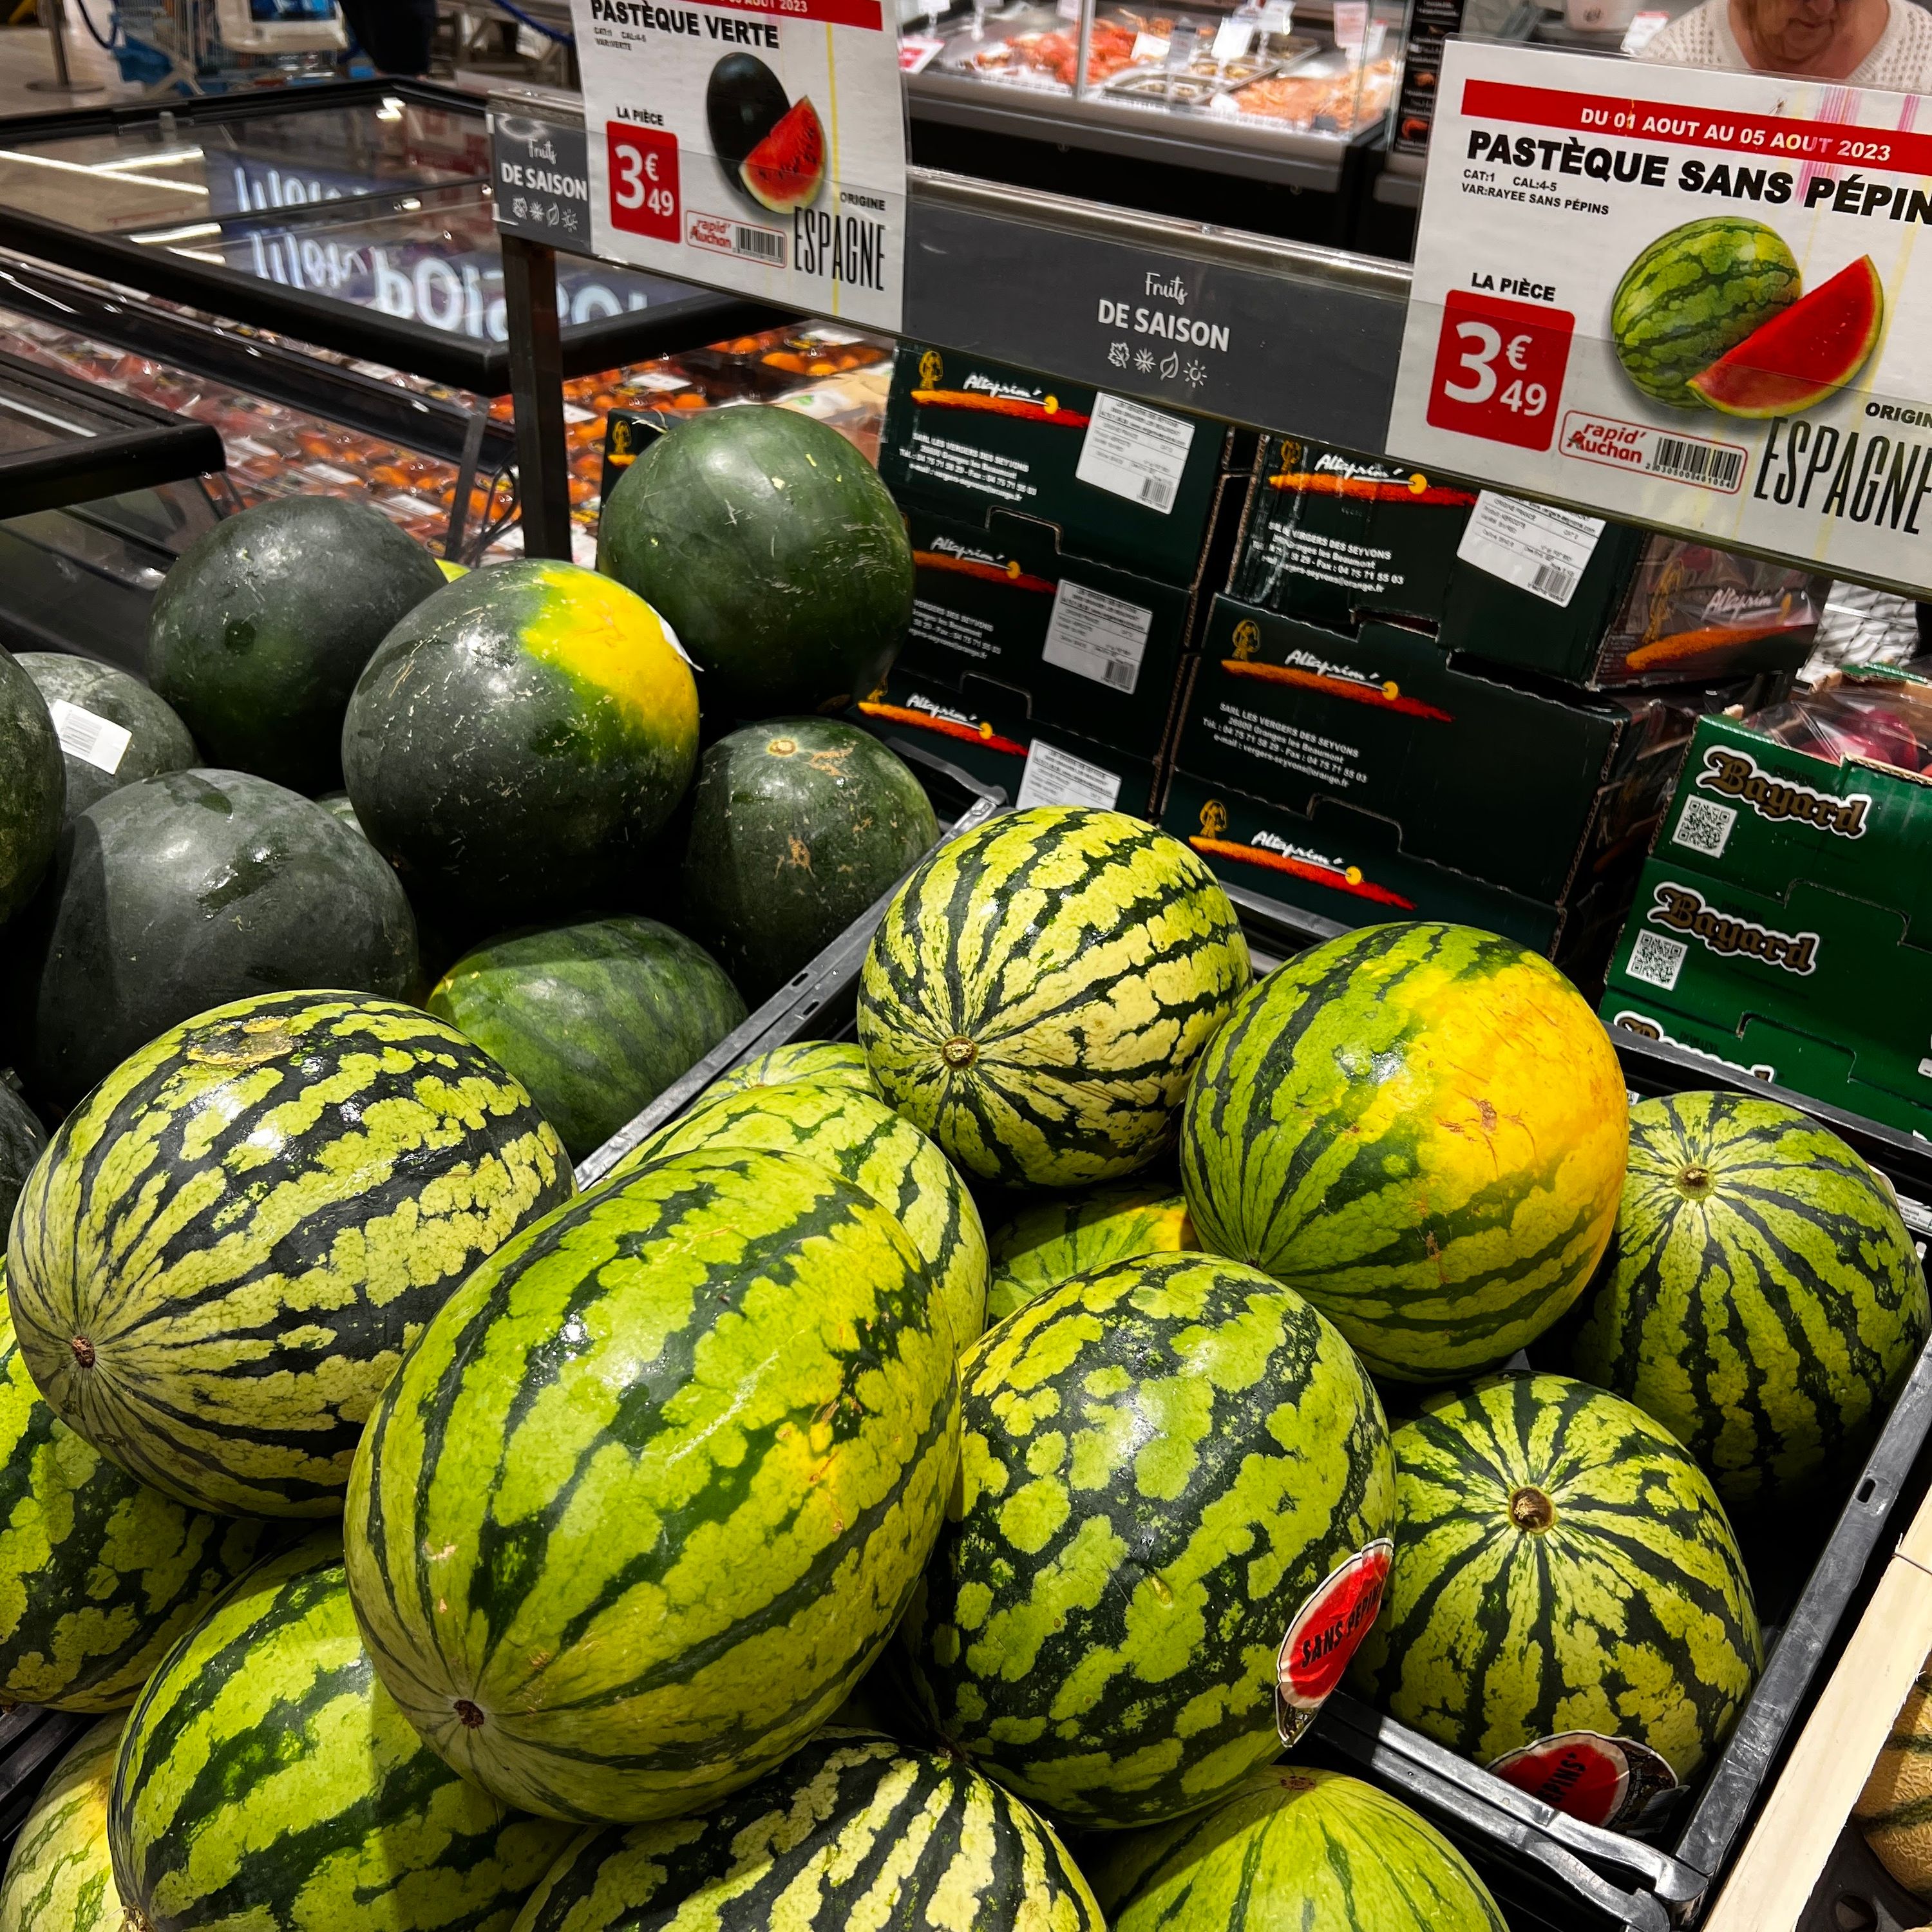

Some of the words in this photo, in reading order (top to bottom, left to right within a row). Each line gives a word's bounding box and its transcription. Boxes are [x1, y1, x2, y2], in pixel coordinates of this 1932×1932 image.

[591, 0, 700, 35] PASTÈQUE
[705, 14, 780, 48] VERTE
[780, 0, 808, 12] 2023
[617, 106, 631, 120] LA
[634, 109, 664, 126] PIÈCE
[1581, 108, 1609, 126] DU
[1613, 112, 1636, 129] 01
[1642, 116, 1700, 137] AOUT
[1704, 124, 1734, 142] AU
[1739, 128, 1765, 146] 05
[1770, 132, 1833, 153] AOUT
[1837, 139, 1891, 162] 2023
[501, 162, 523, 186] DE
[526, 168, 588, 201] SAISON
[615, 144, 645, 209] 3
[647, 189, 674, 216] 49
[1464, 169, 1495, 182] CAT:1
[1513, 176, 1558, 192] CAL:4-5
[1467, 129, 1669, 187] PASTÈQUE
[1678, 159, 1794, 204] SANS
[840, 192, 886, 211] ORIGINE
[1461, 183, 1526, 201] VAR:RAYEE
[1529, 194, 1561, 207] SANS
[1564, 199, 1609, 215] PÉPINS
[690, 225, 732, 249] Auchan
[794, 205, 886, 291] ESPAGNE
[1145, 272, 1188, 305] Fruits
[1472, 272, 1494, 290] LA
[1500, 278, 1556, 301] PIÈCE
[1098, 299, 1130, 329] DE
[1133, 308, 1230, 352] SAISON
[1444, 321, 1502, 404] 3
[1499, 379, 1548, 417] 49
[1566, 431, 1643, 464] Auchan
[1754, 416, 1932, 535] ESPAGNE
[1329, 540, 1347, 552] DES
[1347, 544, 1392, 560] SEYVONS
[1220, 702, 1241, 717] SARL
[1242, 710, 1258, 723] LES
[1260, 716, 1298, 737] VERGERS
[1299, 730, 1317, 743] DES
[1318, 737, 1360, 758] SEYVONS
[1697, 746, 1870, 838] Bayard
[1649, 884, 1819, 974] Bayard
[1302, 1620, 1343, 1668] SANS
